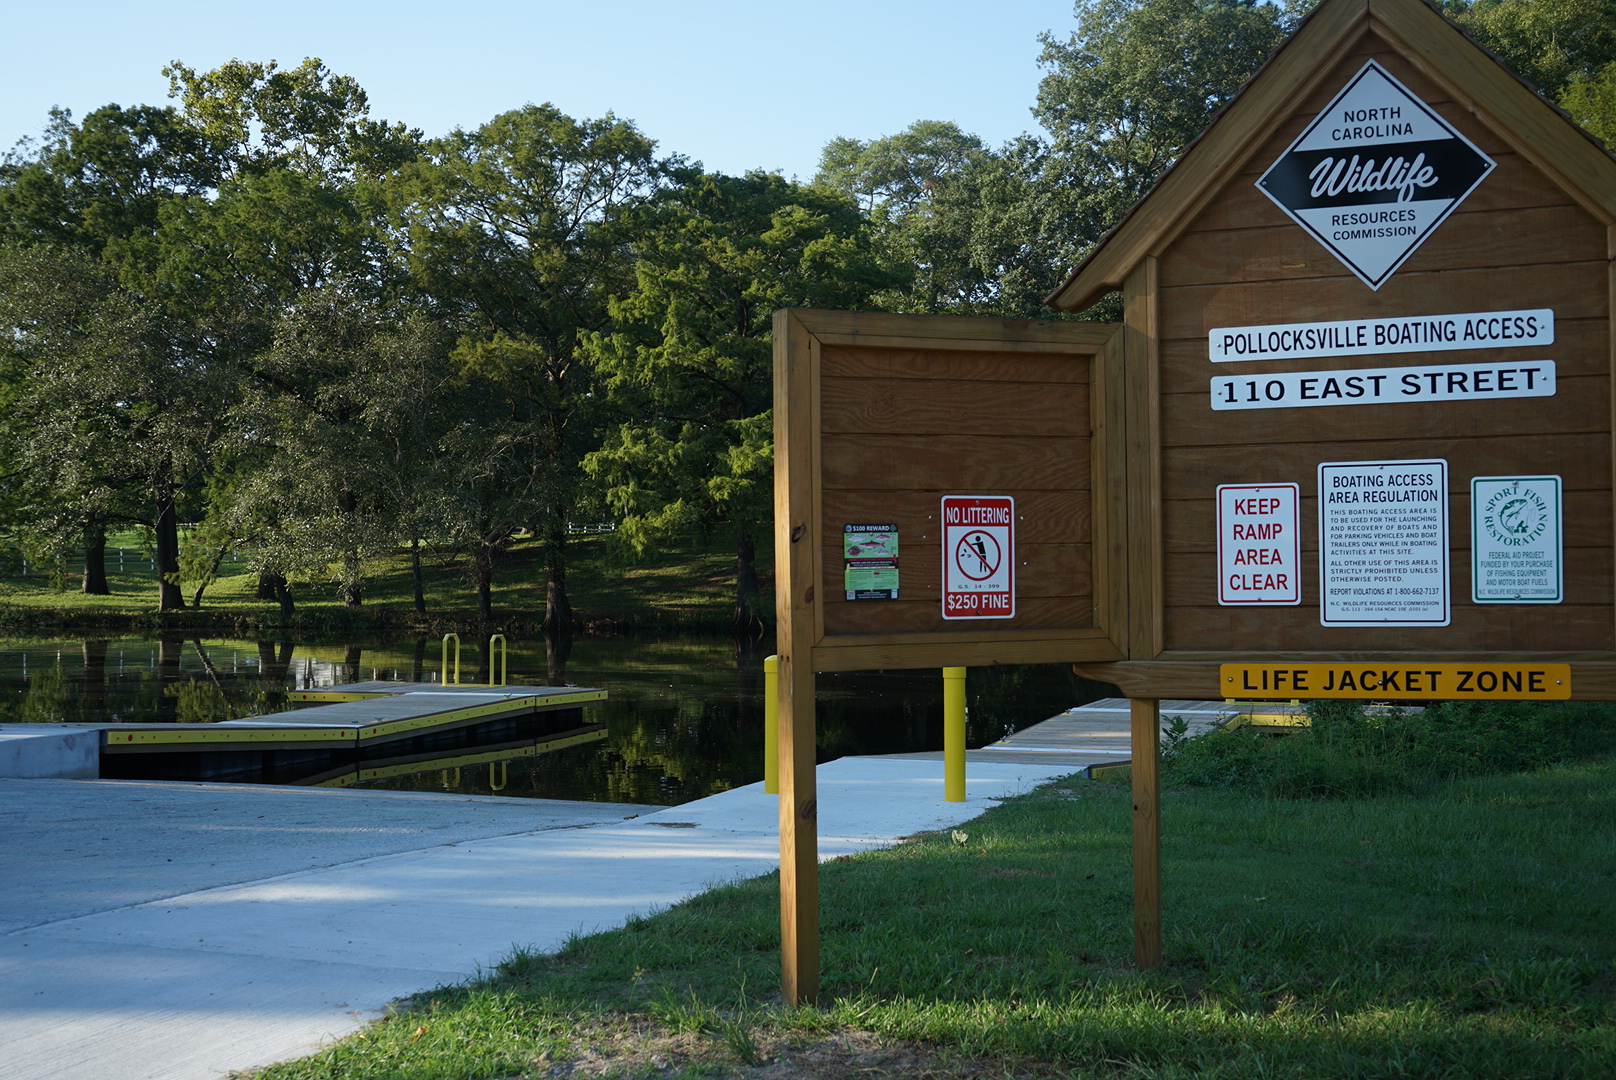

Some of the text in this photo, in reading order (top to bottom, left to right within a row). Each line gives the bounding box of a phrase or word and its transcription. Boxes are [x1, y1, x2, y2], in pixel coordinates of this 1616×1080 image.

[1344, 106, 1401, 123] NORTH
[1332, 123, 1413, 141] CAROLINA
[1309, 152, 1438, 203] Wildlife
[1332, 210, 1416, 226] RESOURCES
[1333, 226, 1416, 241] COMMISSION
[1224, 316, 1538, 356] POLLOCKSVILLE BOATING ACCESS
[1224, 368, 1541, 403] 110 EAST STREET
[1333, 474, 1433, 487] BOATING ACCESS
[1329, 490, 1438, 503] AREA REGULATION
[1485, 486, 1547, 513] SPORT FISH
[947, 507, 1009, 523] NO LITTERING
[1234, 498, 1280, 515] KEEP
[1233, 524, 1282, 540] RAMP
[1484, 513, 1548, 546] RESTORATION
[1234, 549, 1282, 565] AREA
[1230, 574, 1288, 590] CLEAR
[948, 594, 1009, 611] $250 FINE
[1242, 670, 1546, 692] LIFE JACKET ZONE
